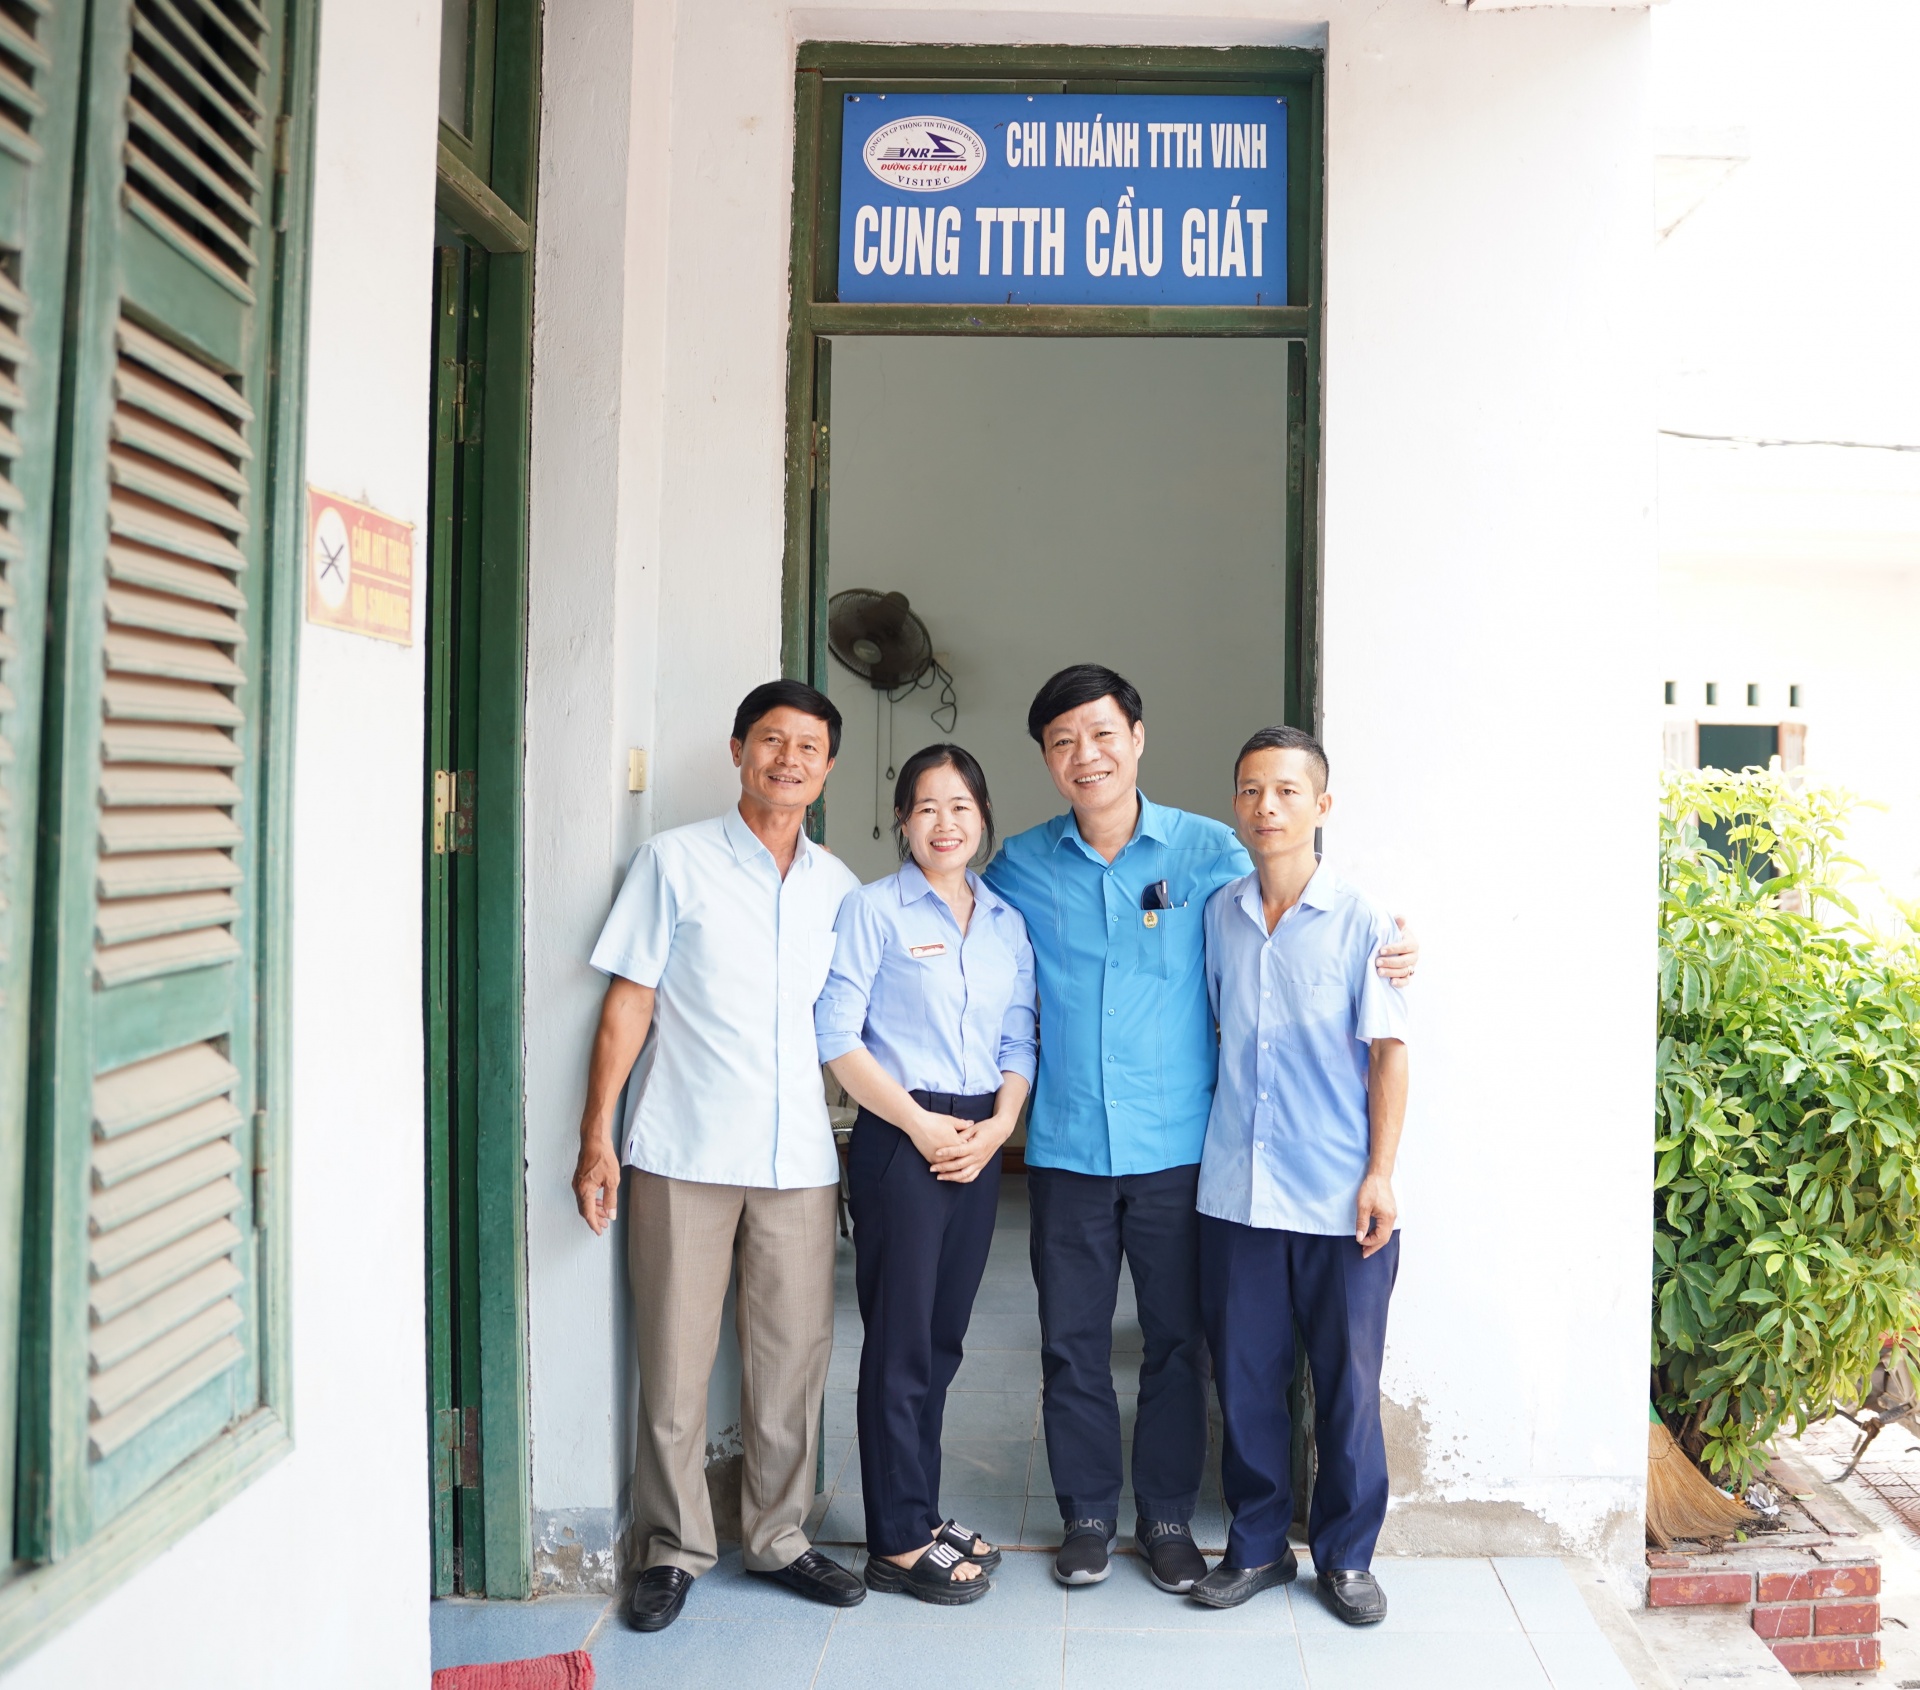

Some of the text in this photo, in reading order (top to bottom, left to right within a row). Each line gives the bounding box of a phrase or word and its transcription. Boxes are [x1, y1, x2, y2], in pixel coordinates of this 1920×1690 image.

[880, 130, 890, 139] TY
[889, 126, 898, 134] CP
[971, 139, 981, 158] VINH
[1006, 113, 1267, 169] CHI NHÁNH TTTH VINH
[899, 147, 930, 158] VNR
[929, 163, 947, 173] VIỆT
[946, 164, 968, 172] NAM
[897, 175, 951, 187] VISITEC
[853, 185, 1268, 277] CUNG TTTH CẦU GIÁT
